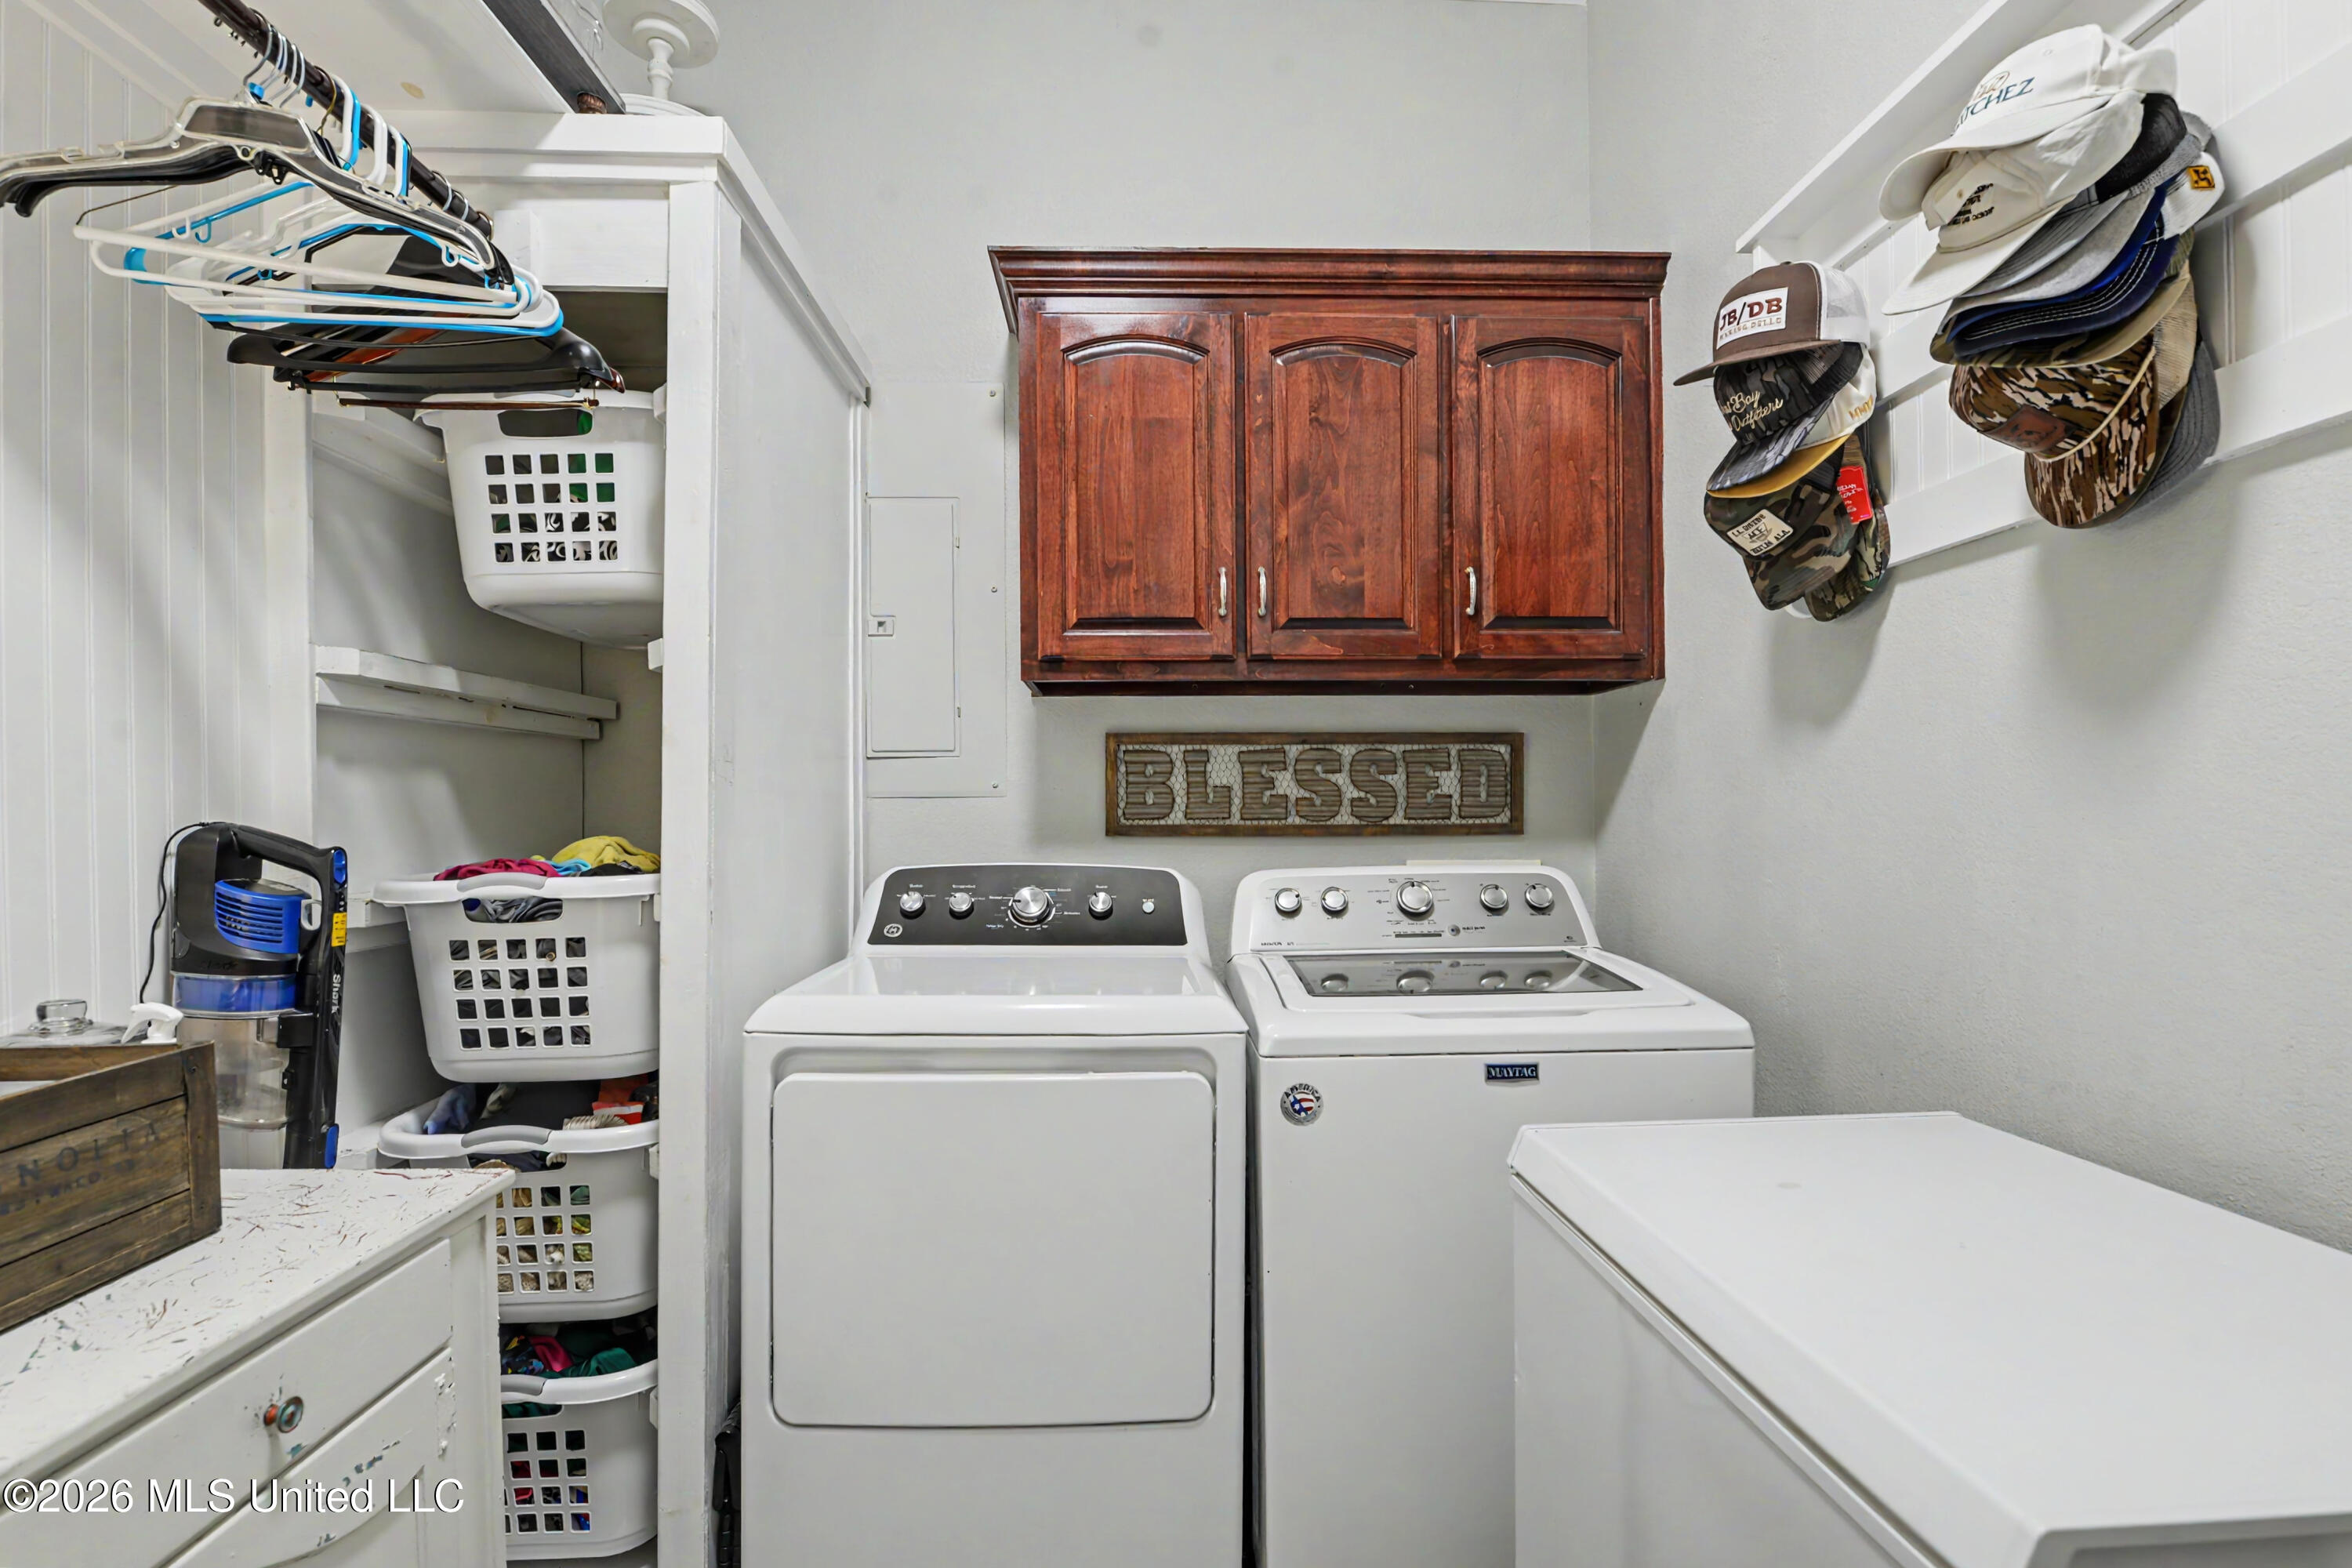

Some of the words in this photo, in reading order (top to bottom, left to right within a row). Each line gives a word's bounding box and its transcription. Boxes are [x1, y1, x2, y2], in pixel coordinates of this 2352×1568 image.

[1719, 297, 1783, 331] JB/DB
[1730, 390, 1761, 413] Bay
[1123, 747, 1510, 823] BLESSED
[331, 974, 341, 1014] Shark
[1488, 1066, 1537, 1078] MAYTAG
